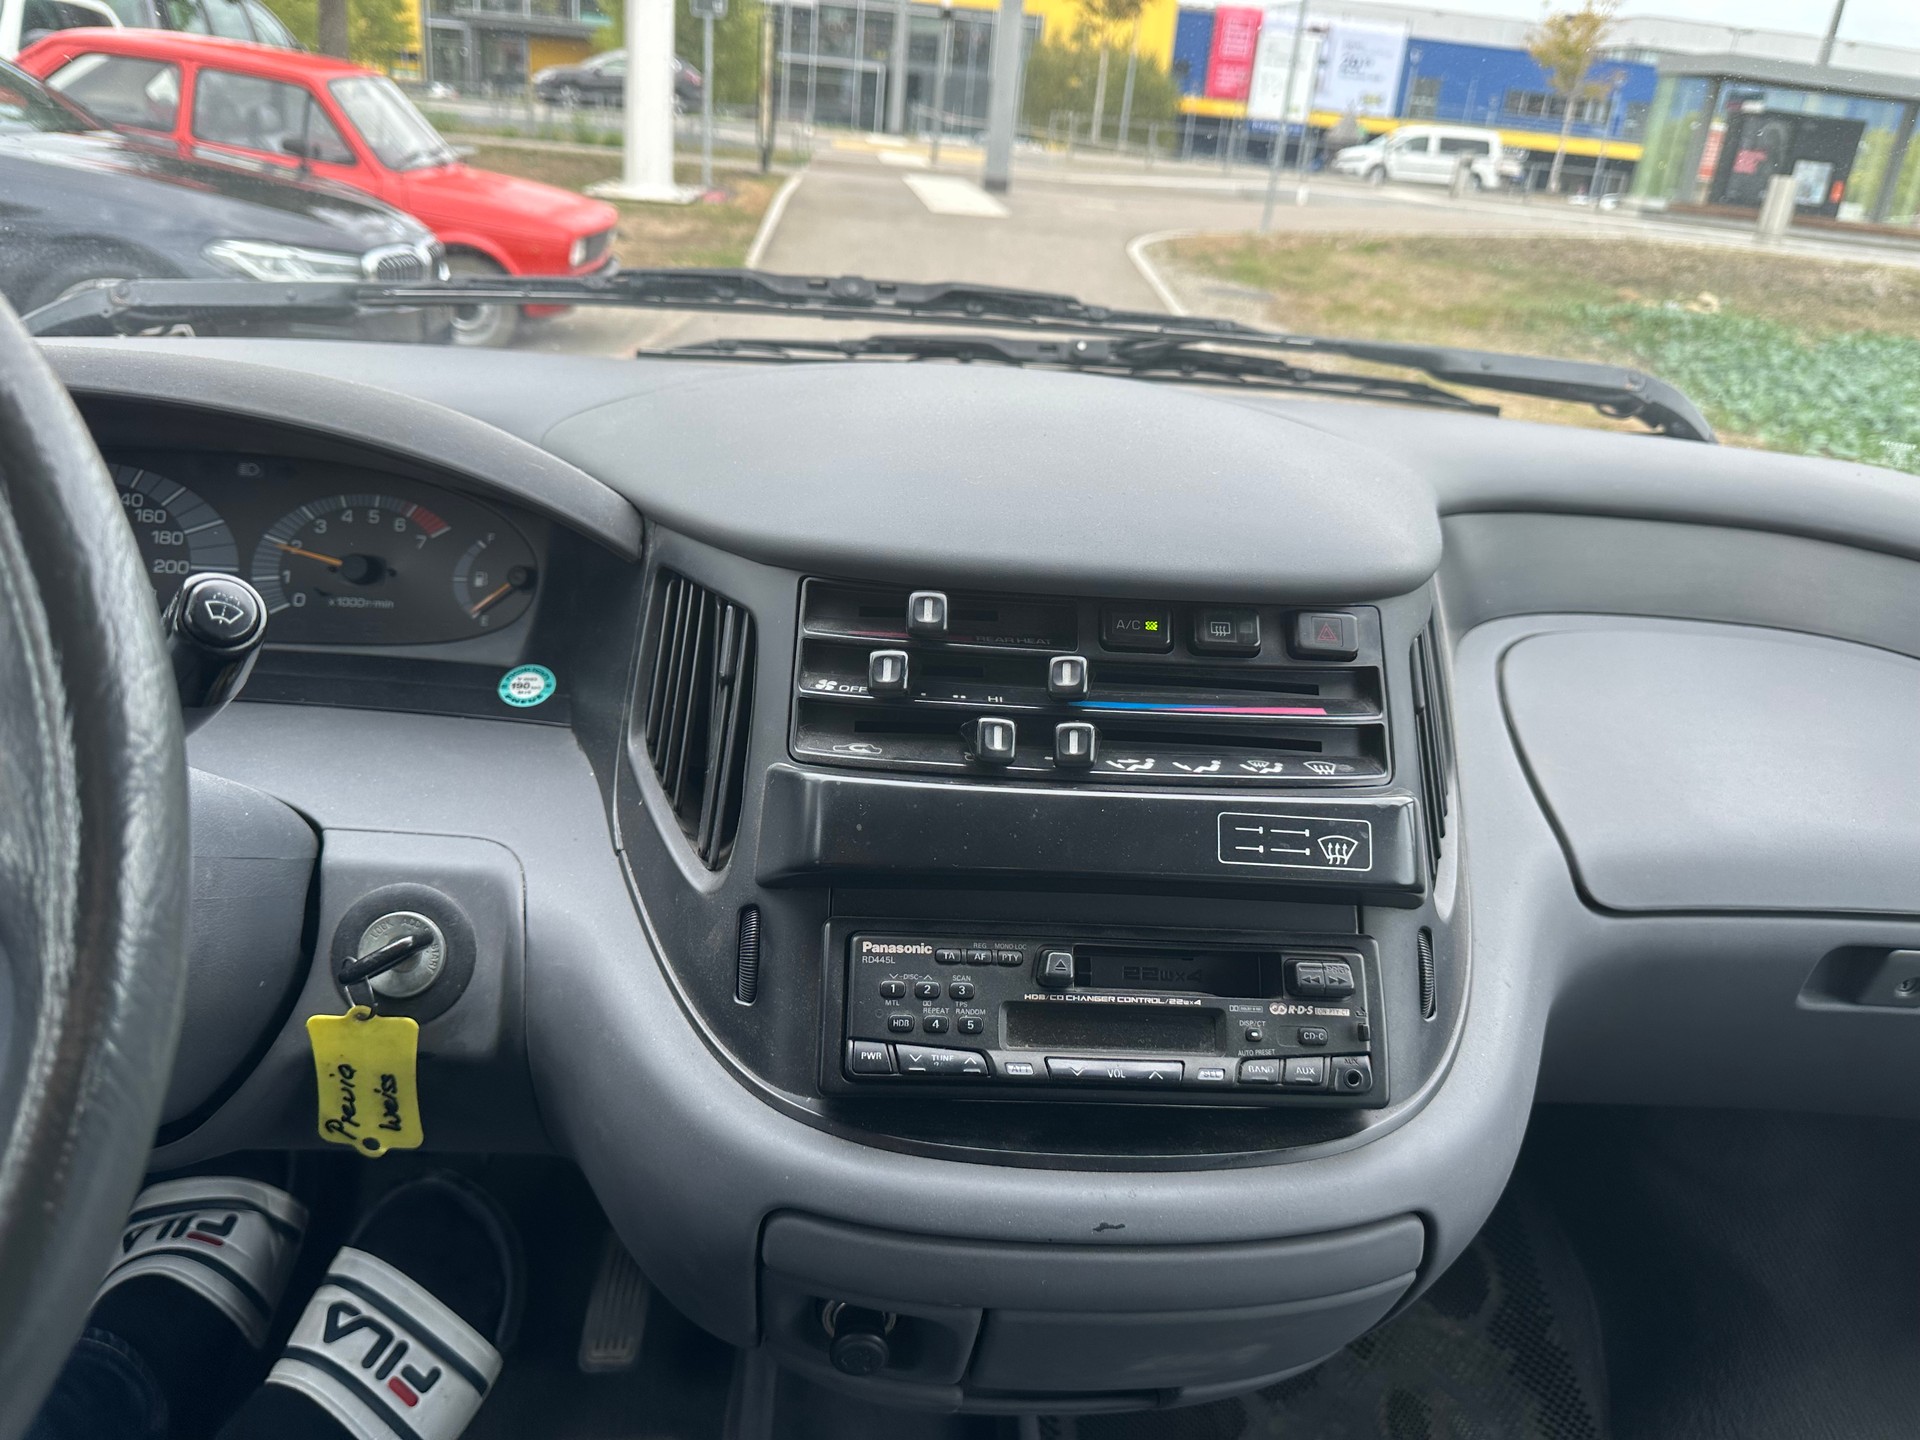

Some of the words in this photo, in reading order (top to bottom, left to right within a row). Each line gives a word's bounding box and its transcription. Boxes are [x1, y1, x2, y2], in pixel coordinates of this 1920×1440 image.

[120, 492, 144, 508] 40
[134, 508, 167, 524] 160
[341, 510, 353, 523] 4
[368, 510, 380, 524] 5
[314, 518, 328, 534] 3
[393, 517, 407, 532] 6
[150, 530, 184, 546] 180
[415, 534, 428, 549] 7
[152, 559, 190, 575] 200
[282, 570, 292, 584] 1
[292, 592, 306, 608] 0
[1116, 619, 1141, 631] A/C
[976, 635, 1014, 644] REAR
[1016, 637, 1051, 646] HEAT
[838, 684, 868, 693] OFF
[987, 695, 1003, 703] HI
[862, 941, 933, 955] Panasonic
[862, 955, 896, 965] RD445L
[943, 952, 956, 960] TA
[974, 953, 987, 961] AF
[1002, 954, 1019, 962] PTY
[952, 974, 972, 982] SCAN
[890, 983, 896, 994] 1
[923, 984, 931, 995] 2
[958, 985, 966, 996] 3
[1065, 994, 1116, 1003] CHANGER
[923, 1007, 949, 1015] REPEAT
[955, 1008, 986, 1016] RANDOM
[892, 1019, 910, 1028] HDB
[932, 1019, 940, 1029] 4
[967, 1020, 975, 1030] 5
[861, 1051, 882, 1061] PWR
[1107, 1068, 1126, 1079] VOL
[1248, 1066, 1274, 1074] BAND
[1295, 1066, 1316, 1075] AUX
[325, 1063, 361, 1141] Previa
[122, 1212, 238, 1254] FILA
[323, 1301, 443, 1408] FILA
